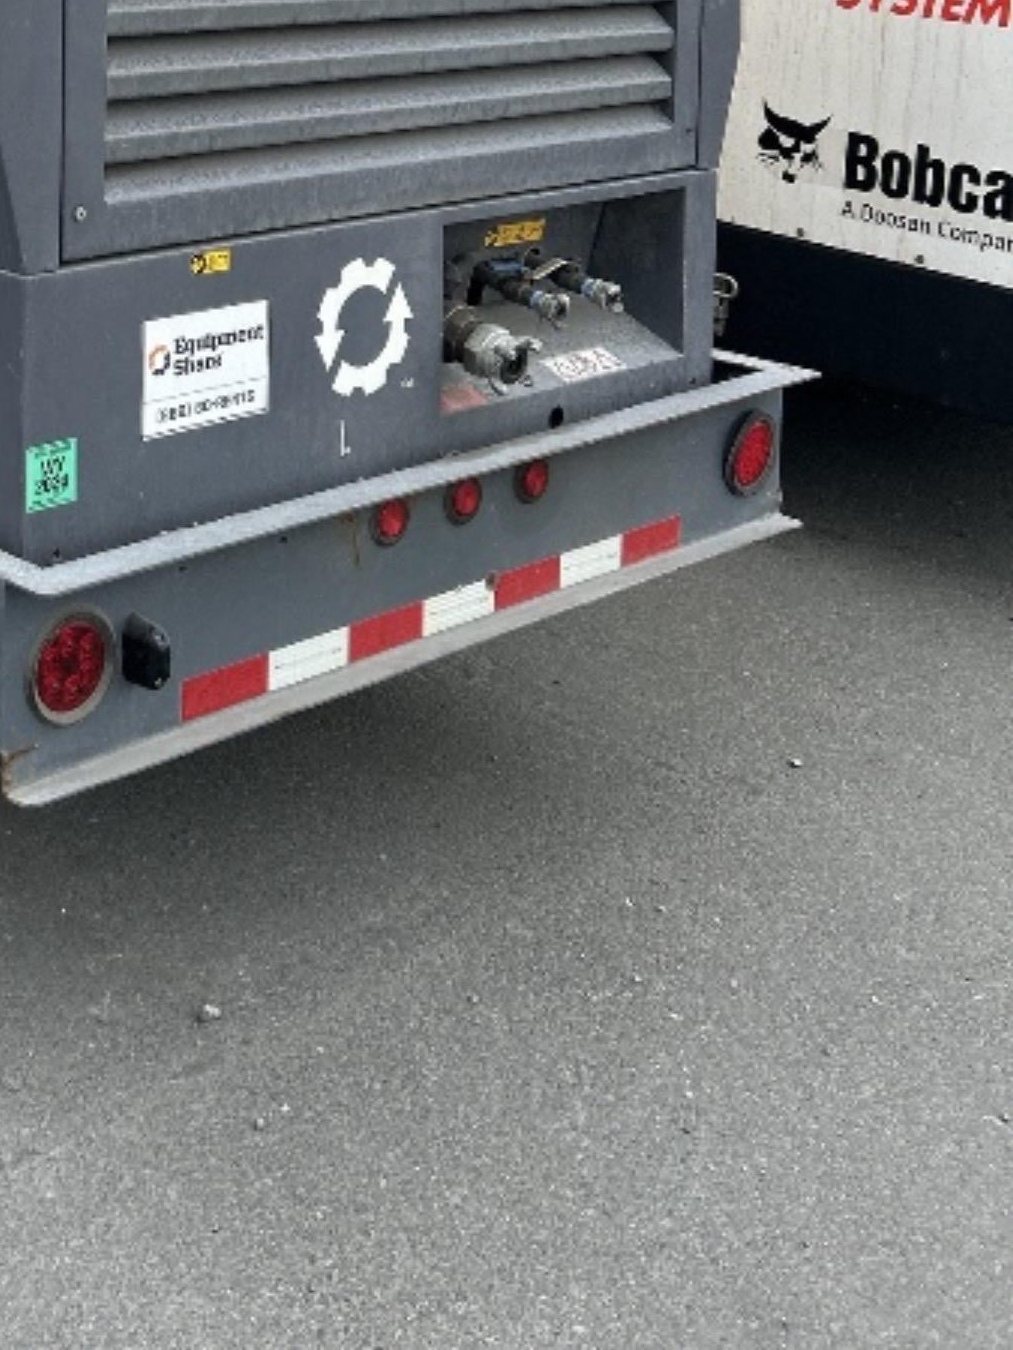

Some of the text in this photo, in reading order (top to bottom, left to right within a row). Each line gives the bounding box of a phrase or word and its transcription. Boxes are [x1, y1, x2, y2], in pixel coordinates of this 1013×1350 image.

[841, 201, 855, 219] A
[860, 203, 931, 235] Doosan
[174, 324, 264, 356] Equipment
